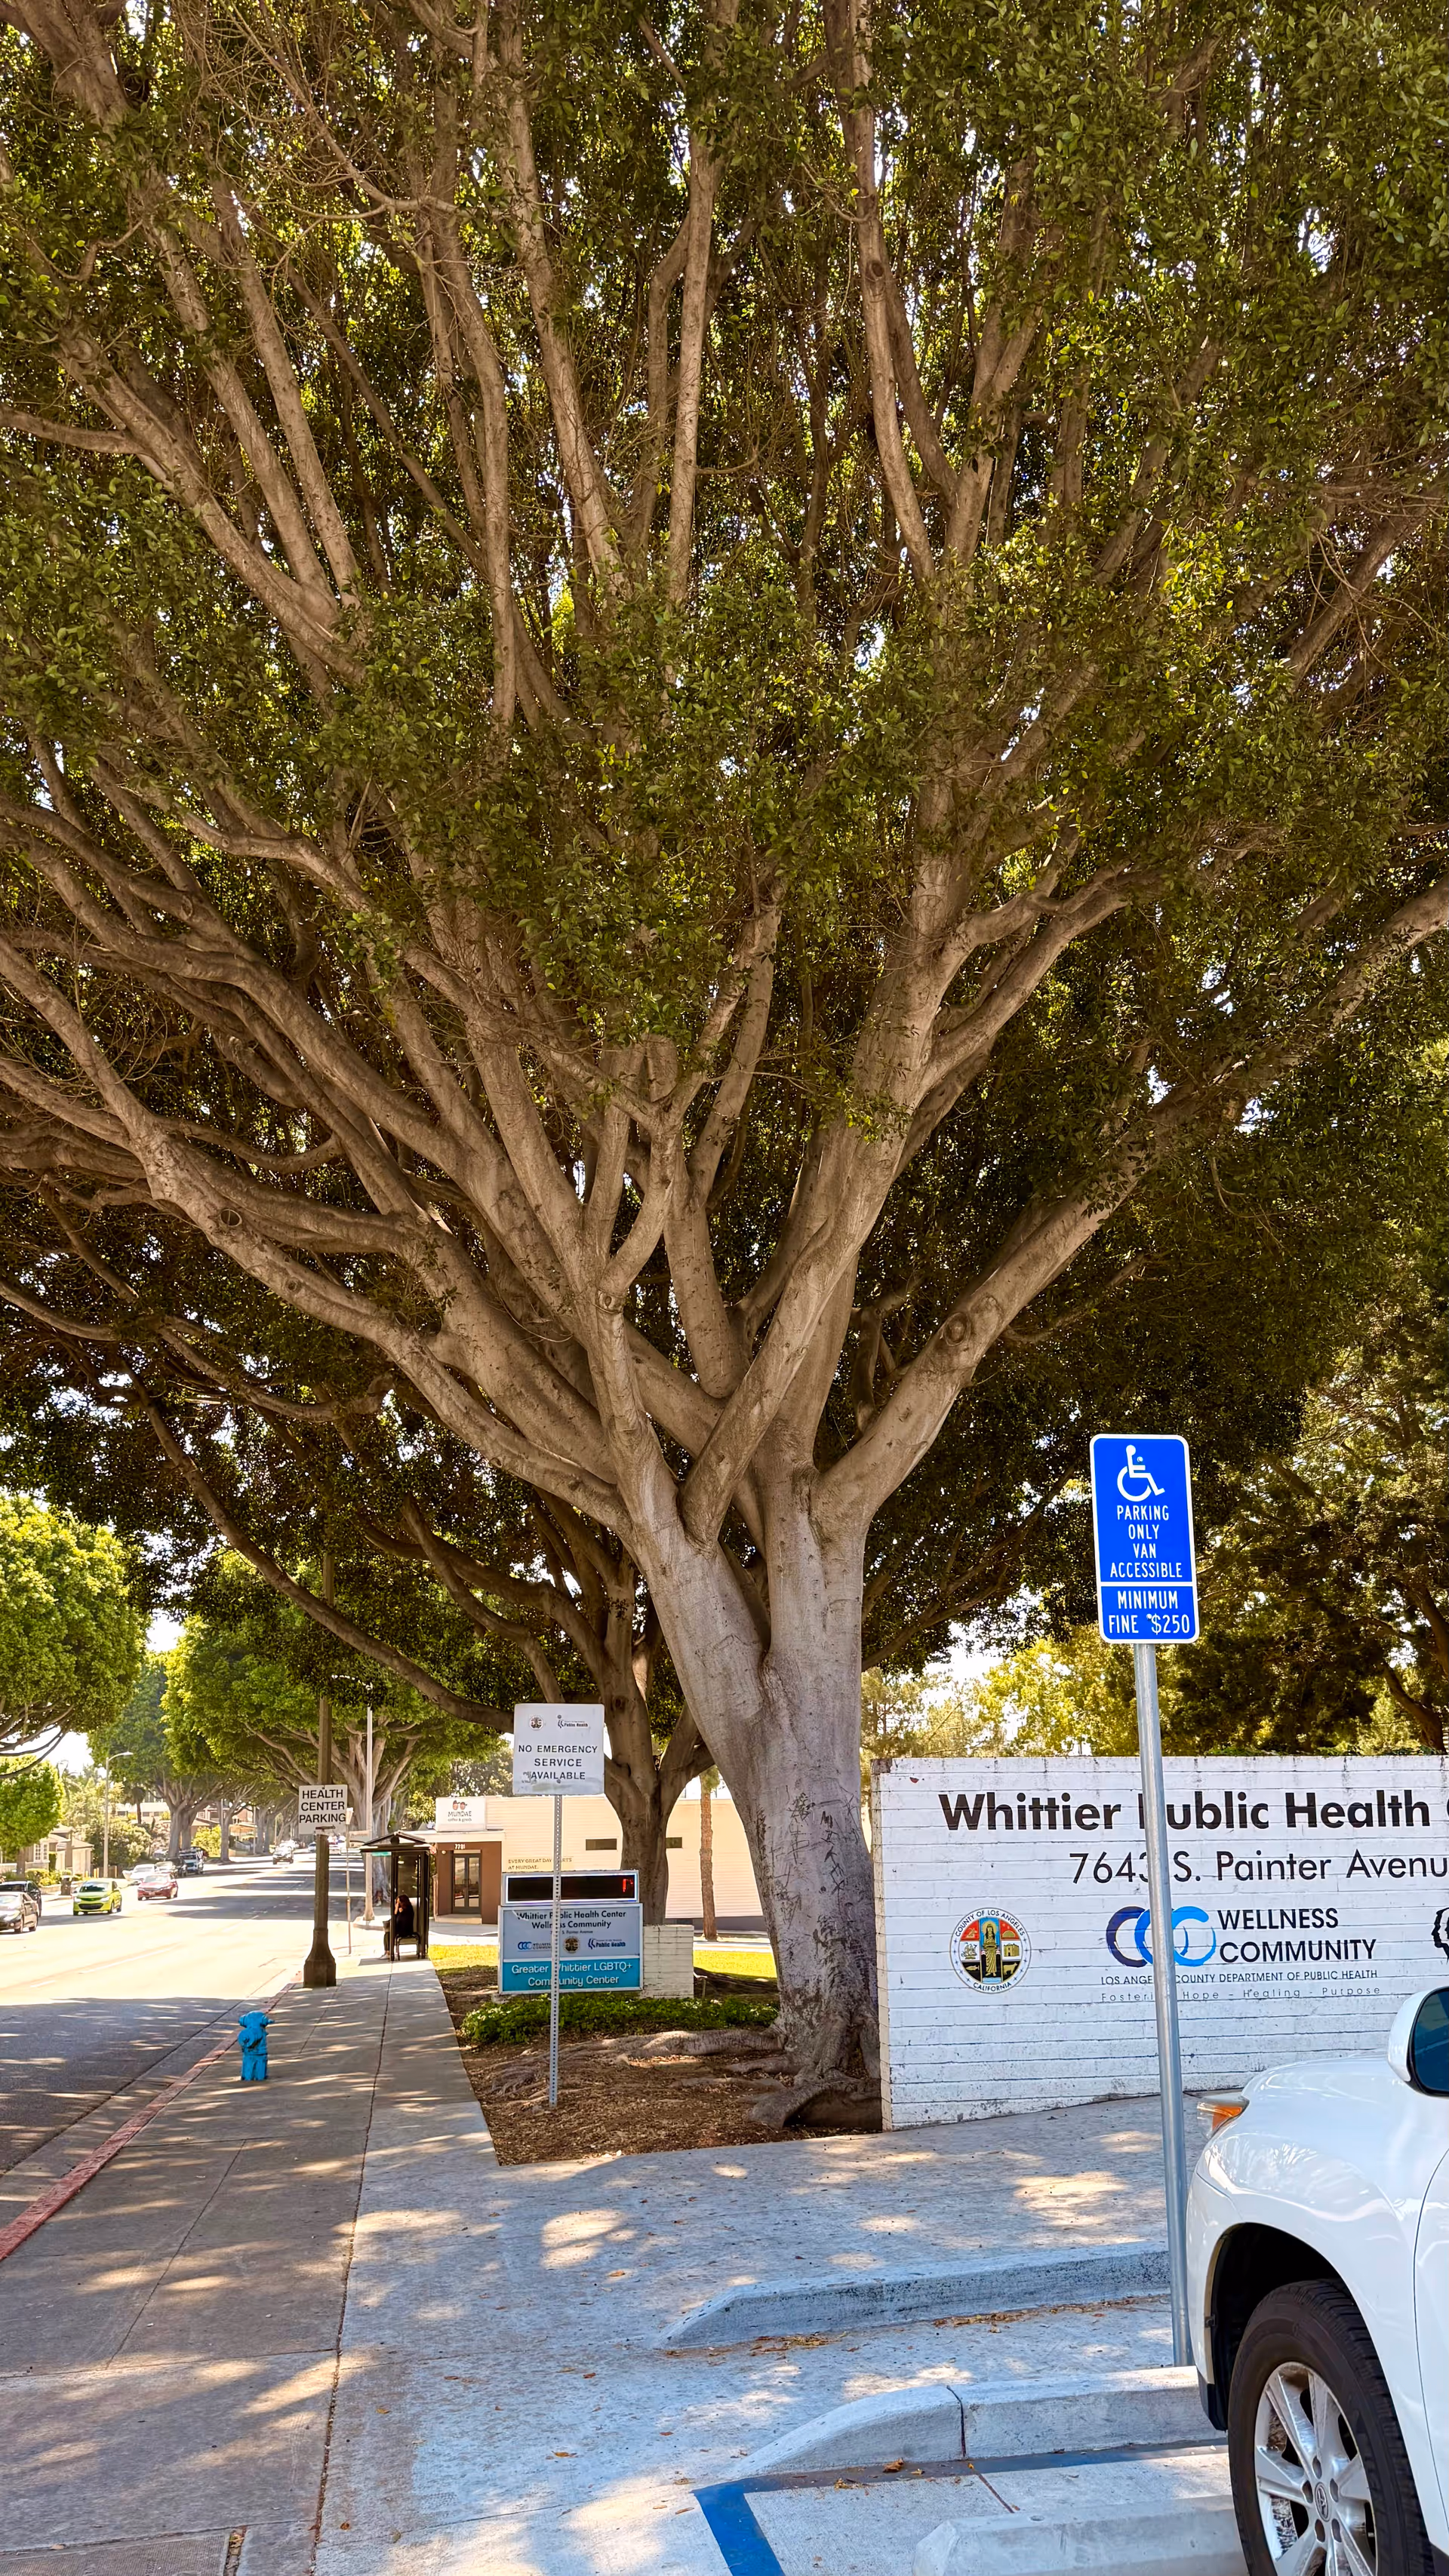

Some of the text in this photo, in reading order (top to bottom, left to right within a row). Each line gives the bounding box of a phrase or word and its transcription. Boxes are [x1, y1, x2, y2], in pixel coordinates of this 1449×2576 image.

[1117, 1505, 1170, 1521] PARKING
[1128, 1523, 1160, 1540] ONLY
[1133, 1543, 1156, 1559] VAN
[1110, 1562, 1183, 1578] ACCESSIBLE
[1118, 1590, 1178, 1609] MINIMUM
[1109, 1613, 1190, 1635] FINE $250
[518, 1744, 598, 1754] NO EMERGENCY
[534, 1758, 582, 1767] SERVICE
[531, 1771, 586, 1780] AVAILABLE
[302, 1789, 343, 1800] HEALTH
[300, 1801, 345, 1812] CENTER
[938, 1792, 1121, 1831] Whittier
[1285, 1790, 1430, 1828] Health
[299, 1812, 346, 1824] PARKING
[1173, 1850, 1201, 1882] S.
[1216, 1849, 1331, 1881] Painter
[517, 1911, 547, 1920] Whittier
[1217, 1907, 1339, 1930] WELLNESS
[568, 1920, 612, 1929] Community
[955, 1914, 975, 1938] COUNTY
[1001, 1913, 1026, 1936] ANGELES
[1220, 1938, 1377, 1963] COMMUNITY
[511, 1961, 632, 1974] Greater hittier LGBTQ+
[528, 1975, 619, 1987] Comunity Center
[1101, 1975, 1120, 1985] LOS
[1123, 1975, 1152, 1984] ANGE
[1220, 1972, 1283, 1983] DEPARTMENT
[1287, 1972, 1300, 1981] OF
[1304, 1970, 1338, 1981] PUBLIC
[1341, 1969, 1378, 1980] HEALTH
[973, 1981, 1012, 1992] CALIFORNIA
[1102, 1992, 1153, 2002] Fosteri
[1183, 1991, 1219, 2001] Hope
[1243, 1989, 1300, 1999] Healing
